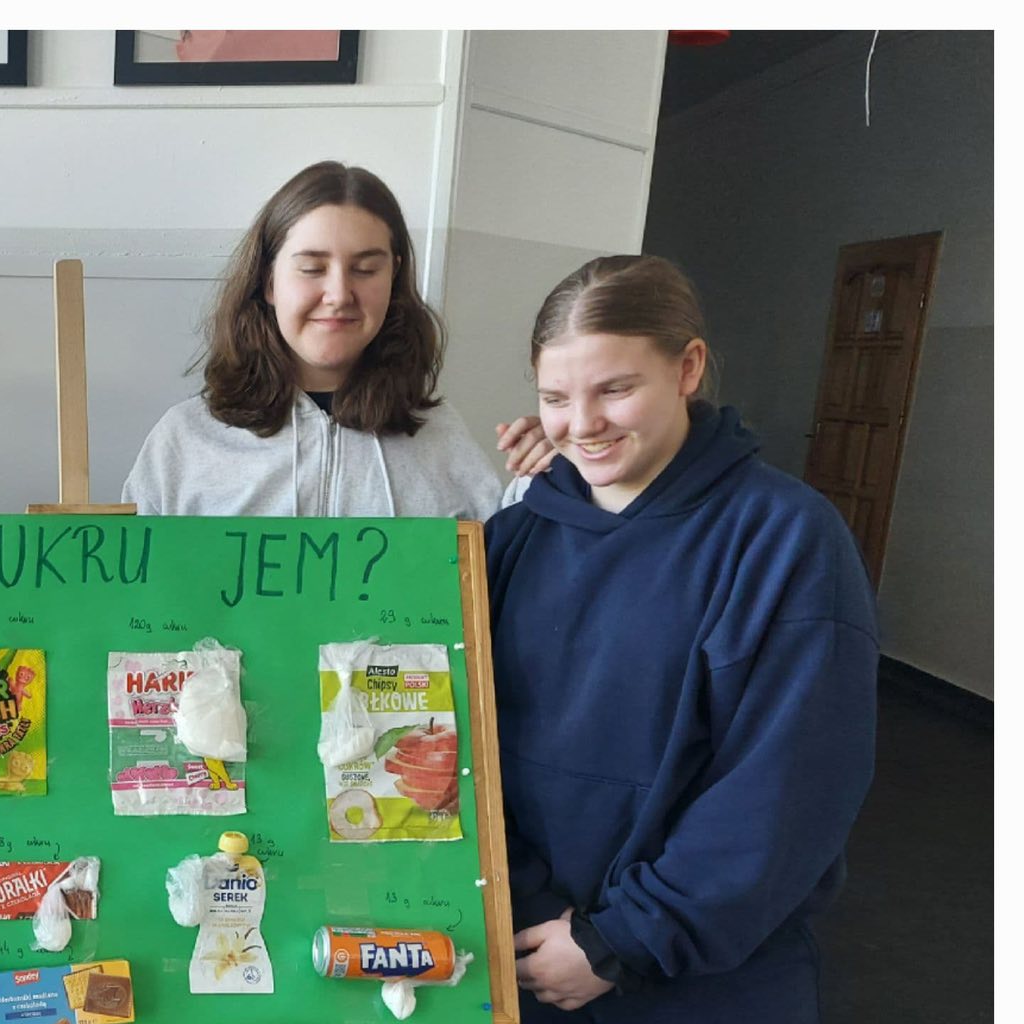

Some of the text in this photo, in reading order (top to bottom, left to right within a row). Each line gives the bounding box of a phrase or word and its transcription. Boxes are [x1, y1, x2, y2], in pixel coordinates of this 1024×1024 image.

[127, 671, 198, 694] HARI
[367, 678, 397, 691] Chipsy
[213, 892, 248, 902] SEREK
[360, 942, 434, 970] FANTA
